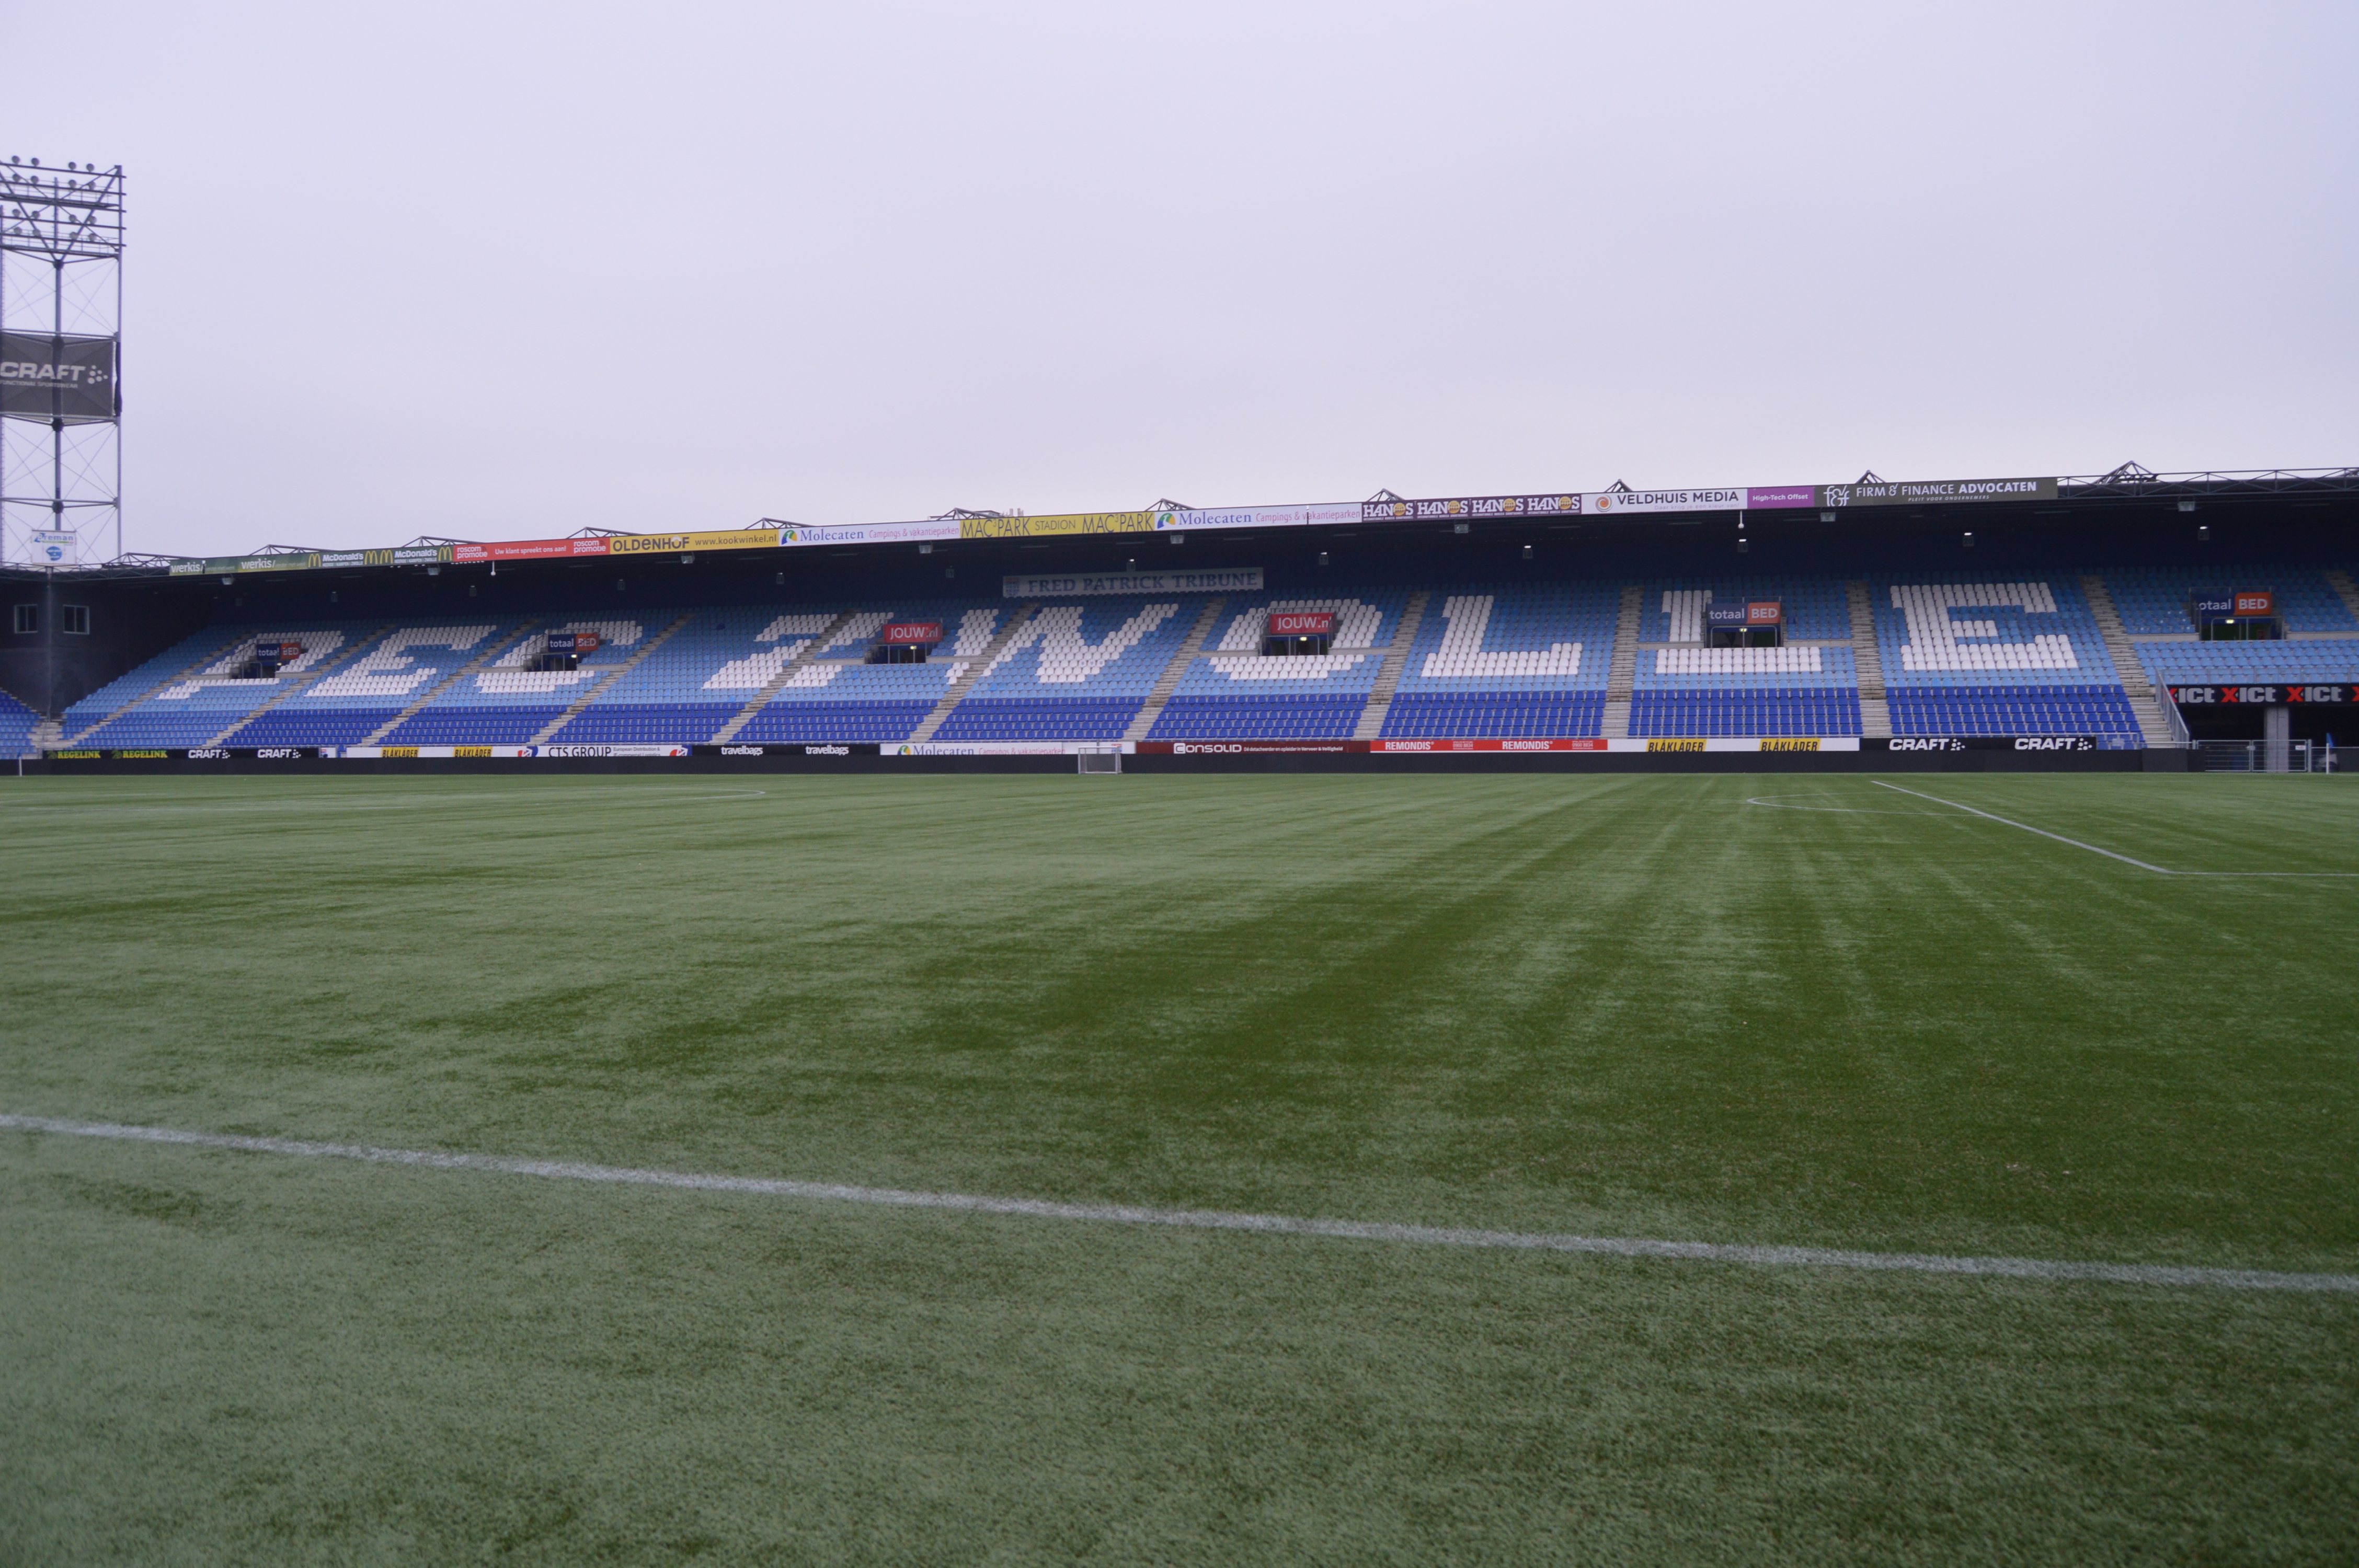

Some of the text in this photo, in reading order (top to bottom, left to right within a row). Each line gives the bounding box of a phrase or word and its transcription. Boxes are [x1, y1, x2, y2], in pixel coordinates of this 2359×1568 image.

[0, 362, 86, 381] CRAFT
[1856, 481, 2037, 498] FIRM & FINANCE ADVOCATEN
[1617, 491, 1739, 505] VELDHUIS MEDIA
[1178, 511, 1252, 525] Molecaten
[1255, 510, 1360, 523] Campings & vakantieparken
[1035, 520, 1076, 532] STADION
[799, 528, 864, 541] Molecaten
[868, 526, 959, 539] Campings & vakantieparken
[694, 534, 777, 546] www.kookwinkel.nl
[394, 549, 438, 558] McDonald's
[456, 550, 488, 559] promotie
[520, 547, 542, 555] spreekt
[574, 545, 606, 555] promotie
[322, 553, 364, 562] McDonald's
[1028, 572, 1258, 593] FRED PATRICK TRIBUNE
[2238, 598, 2268, 609] BED
[1709, 608, 1778, 619] totaal BED
[549, 638, 597, 648] totaal BED
[283, 647, 299, 655] BED
[913, 744, 974, 755] Molecaten
[1648, 739, 1704, 752] BLÅKLÄDER
[1761, 739, 1818, 752] BLÅKLÄDER
[1889, 739, 1950, 751] CRAFT
[2014, 738, 2076, 750] CRAFT
[57, 751, 101, 759] REGELINK
[122, 750, 168, 758] REGELINK
[188, 749, 222, 758] CRAFT
[257, 748, 292, 758] CRAFT
[382, 748, 418, 758] BLÅKLÄDER
[454, 747, 492, 757] BLÅKLÄDER
[548, 746, 611, 757] CTS GROUP
[720, 745, 763, 756] travelbags
[805, 745, 849, 756] travelbags
